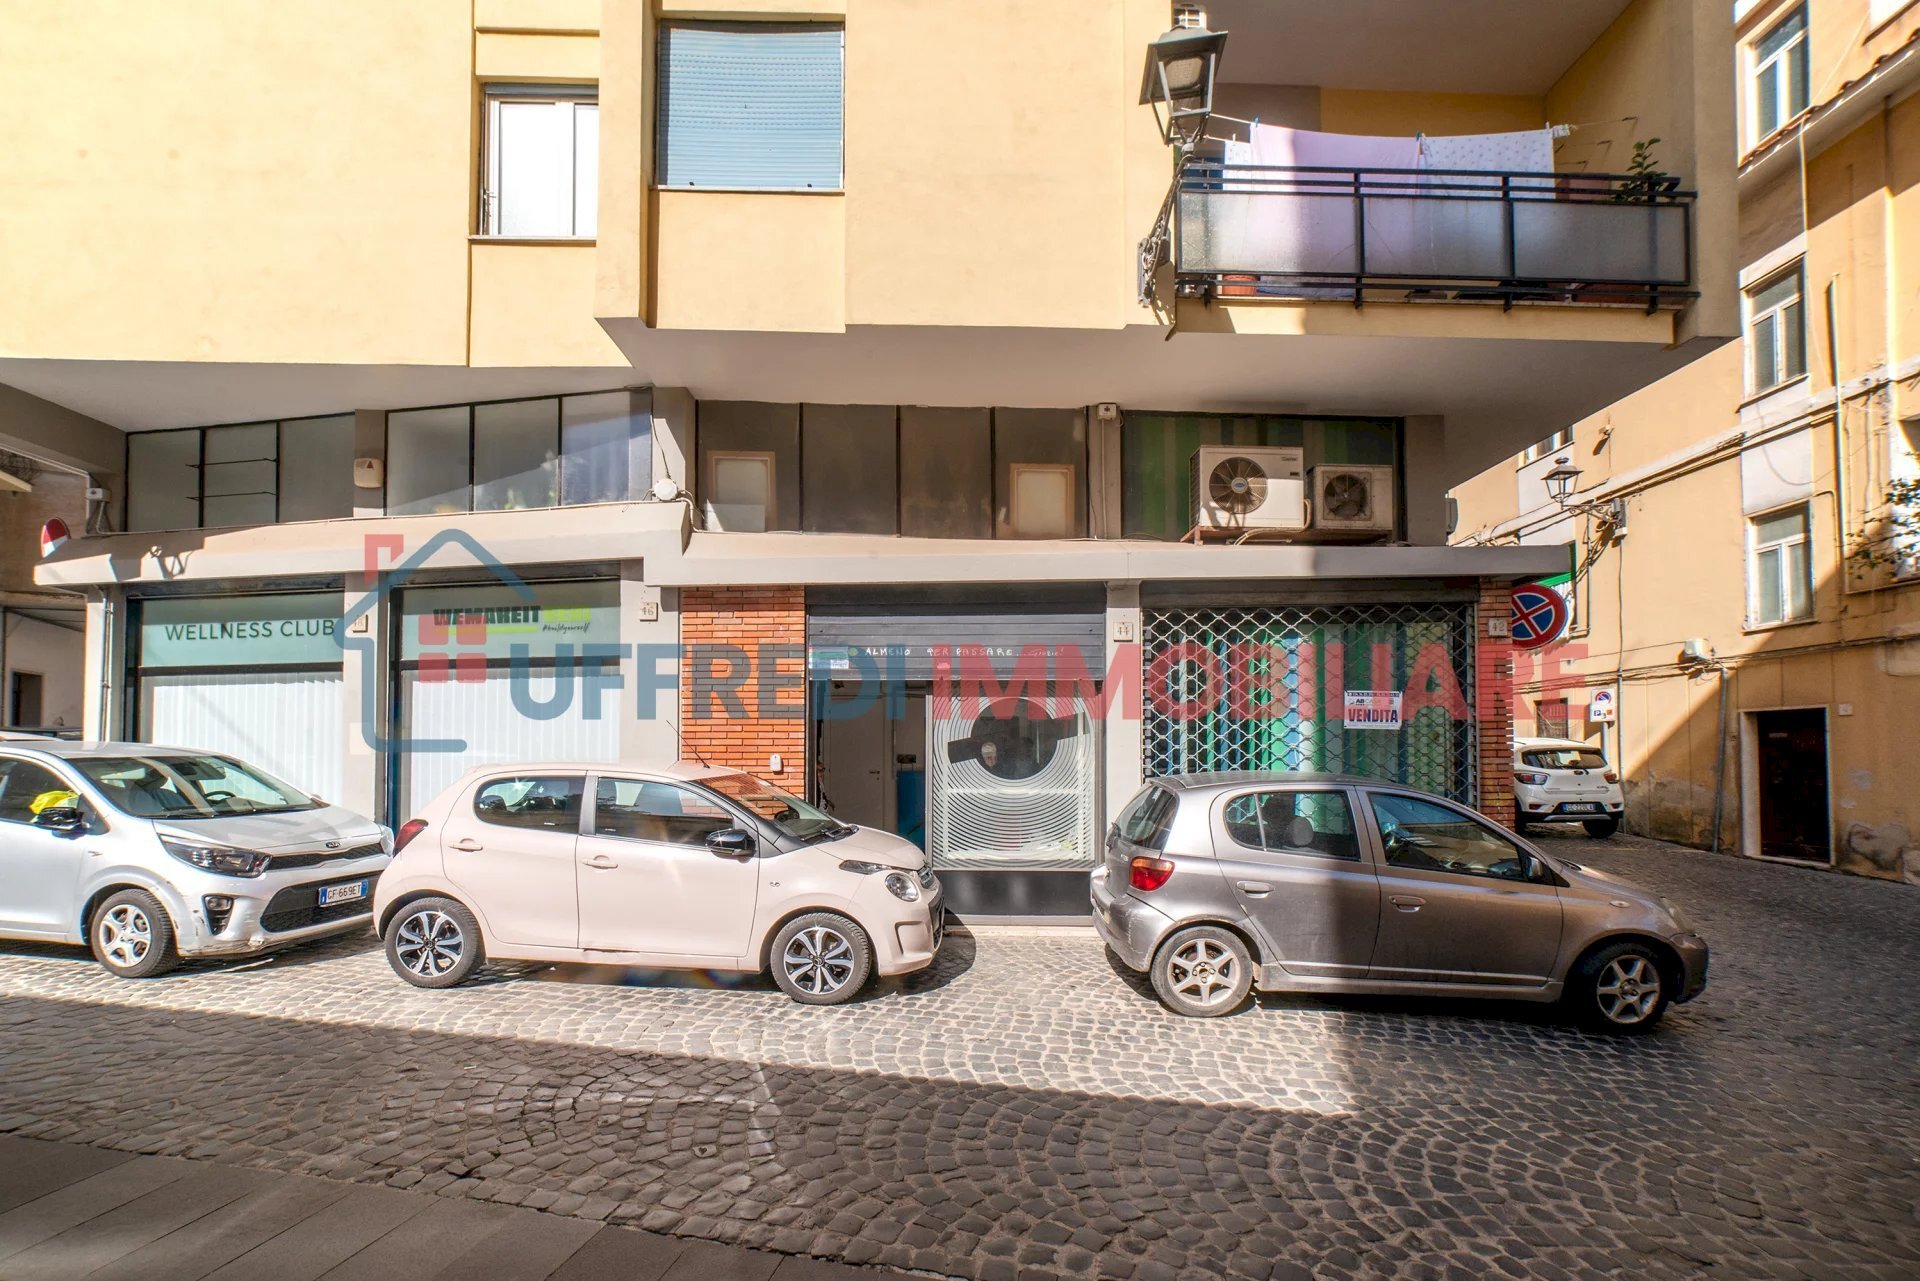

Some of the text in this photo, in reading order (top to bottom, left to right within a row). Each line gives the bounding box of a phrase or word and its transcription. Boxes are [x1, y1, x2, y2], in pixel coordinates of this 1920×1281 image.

[165, 619, 335, 641] WELLNESS CLUB
[865, 647, 911, 656] ALMENO
[1348, 709, 1398, 722] VENDITA
